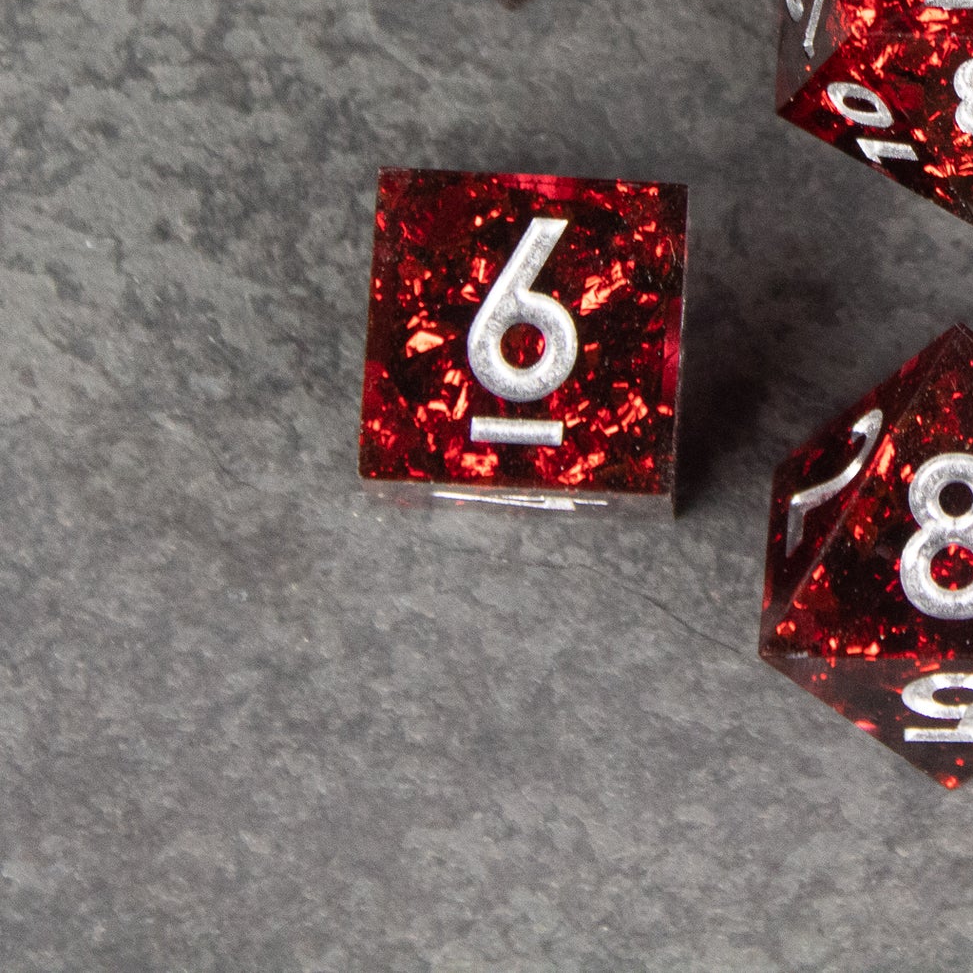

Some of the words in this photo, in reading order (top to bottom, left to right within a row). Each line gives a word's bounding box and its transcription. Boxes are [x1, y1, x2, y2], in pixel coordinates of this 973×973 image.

[826, 80, 919, 165] 10
[466, 216, 579, 403] 6
[786, 408, 884, 538] 2
